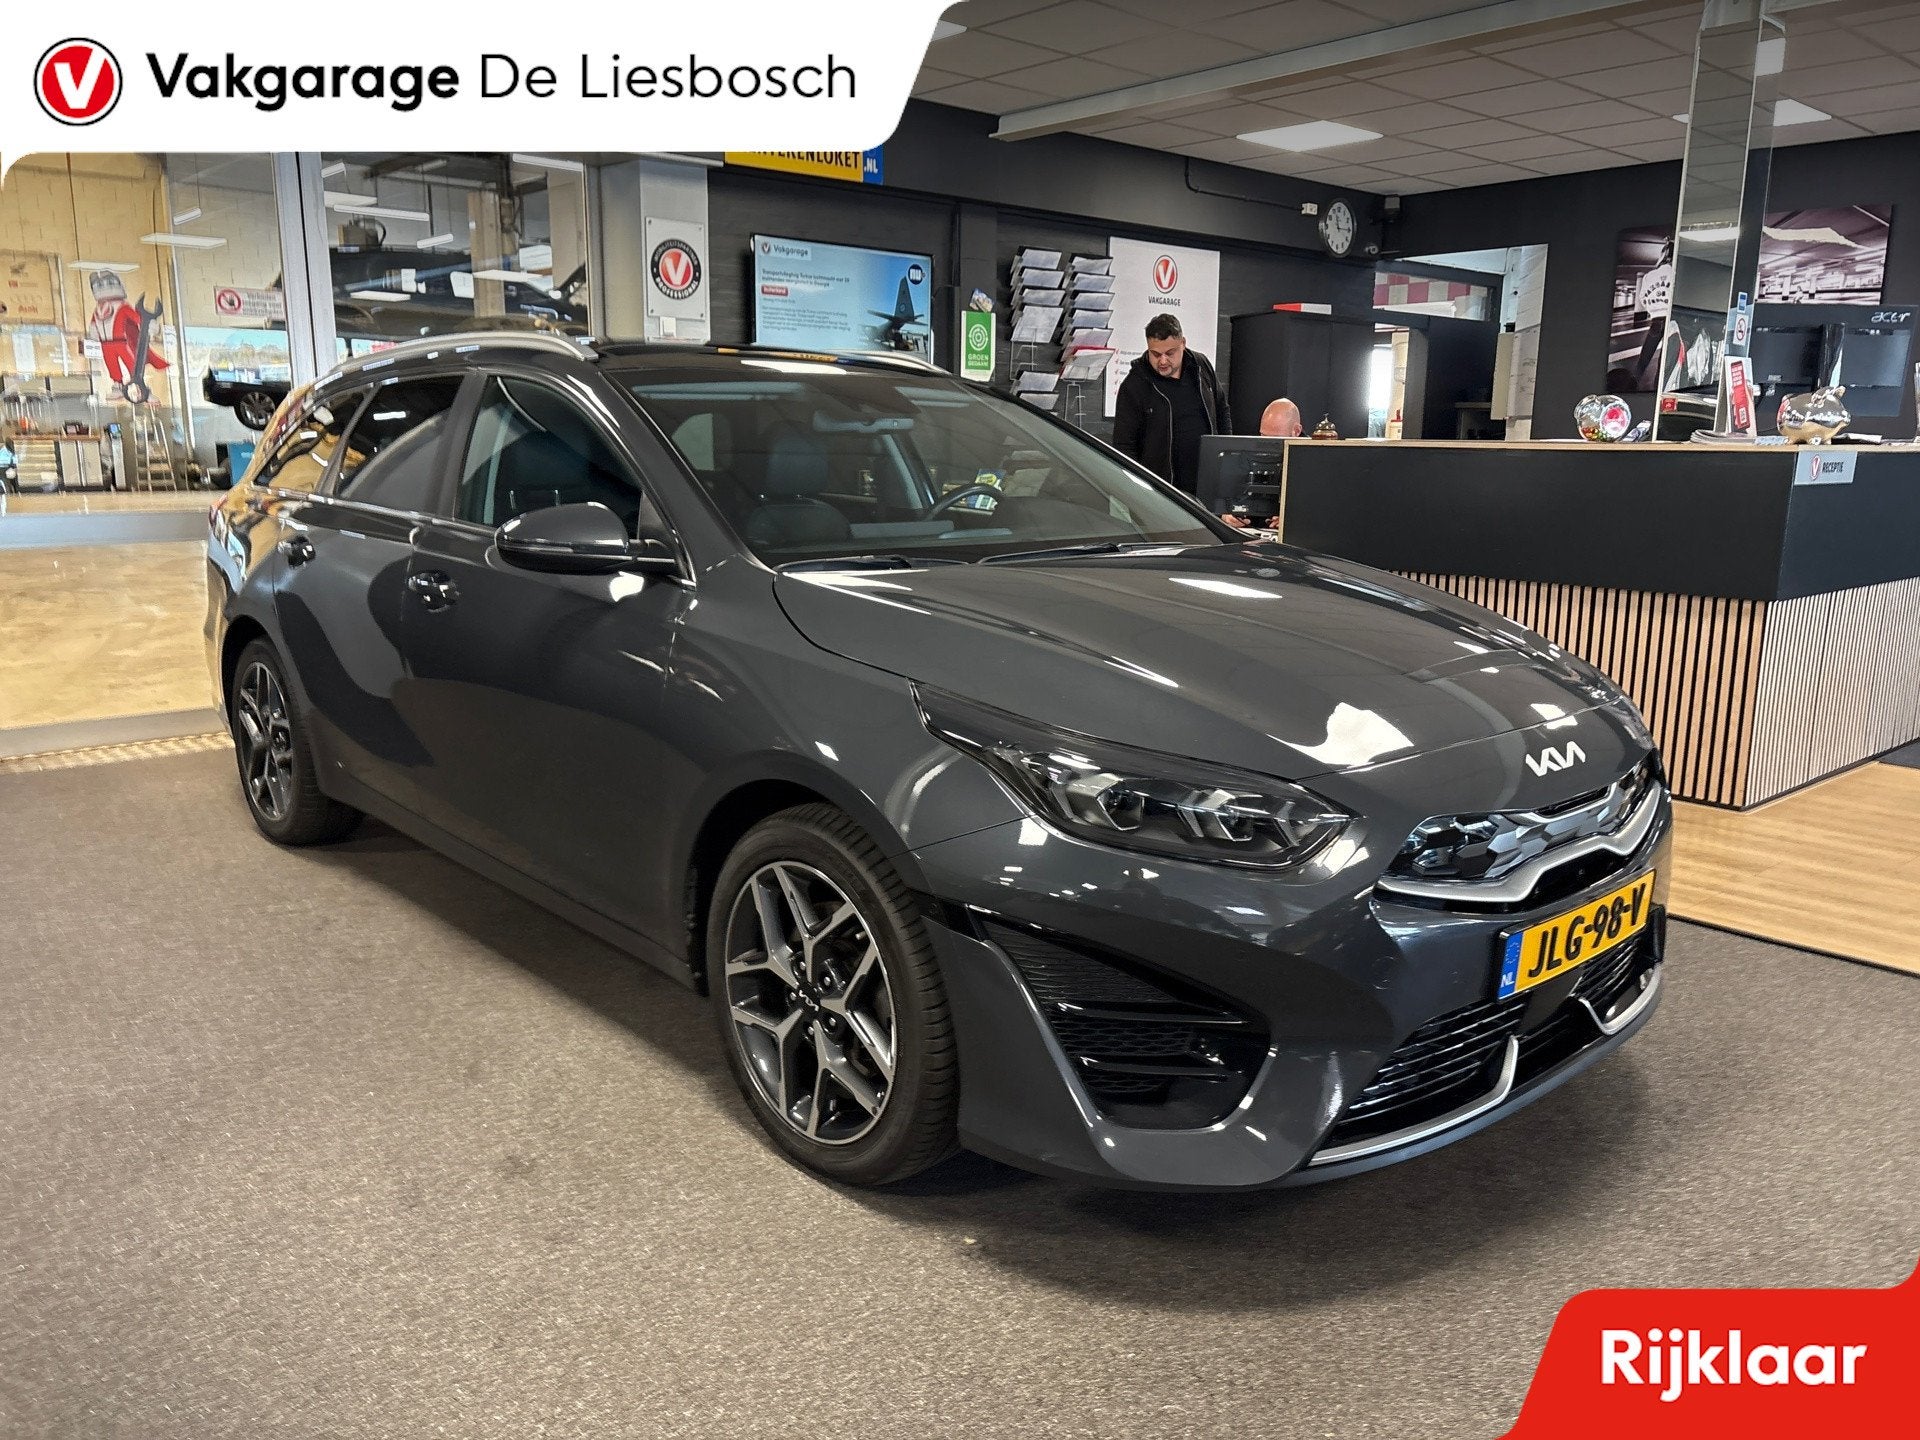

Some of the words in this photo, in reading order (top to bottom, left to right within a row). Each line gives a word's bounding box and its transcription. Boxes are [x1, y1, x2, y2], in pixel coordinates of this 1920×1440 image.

[773, 244, 808, 257] Vakgarage
[1148, 296, 1181, 307] VAKGARAGE
[1525, 740, 1586, 777] KIA
